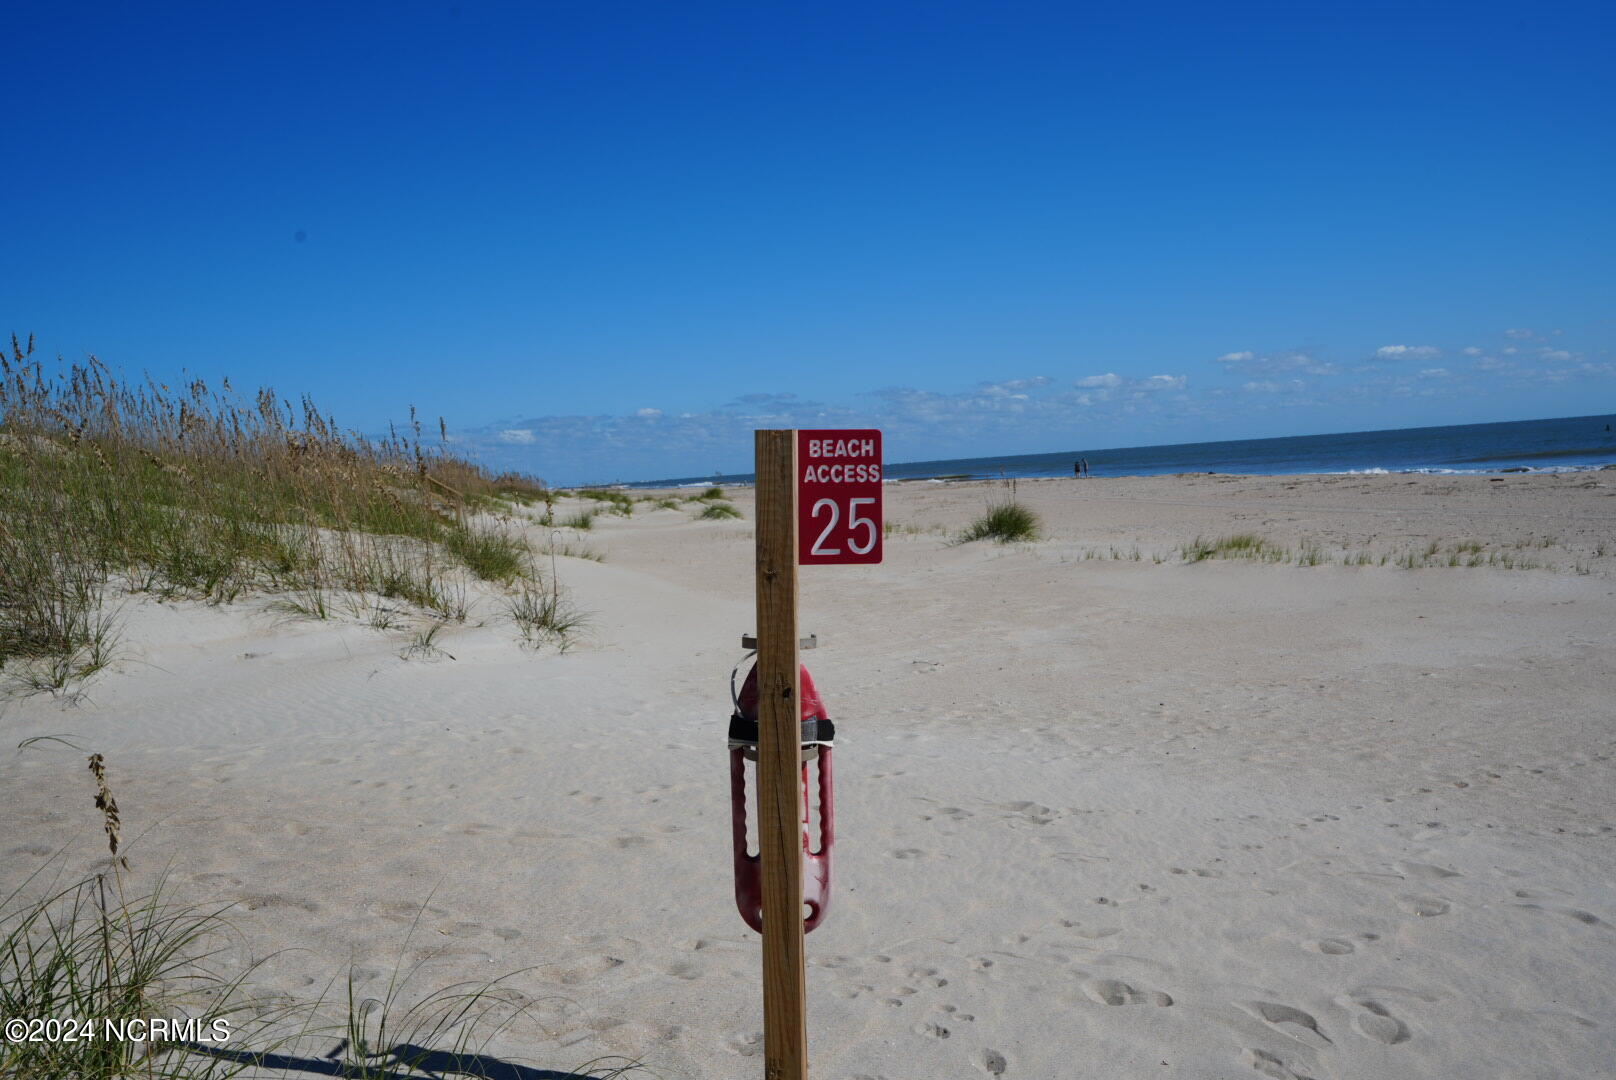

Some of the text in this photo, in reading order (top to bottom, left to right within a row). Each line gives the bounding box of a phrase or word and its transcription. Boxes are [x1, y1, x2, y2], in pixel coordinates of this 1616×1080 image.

[808, 439, 874, 458] BEACH
[803, 464, 880, 483] ACCESS
[810, 497, 877, 556] 25
